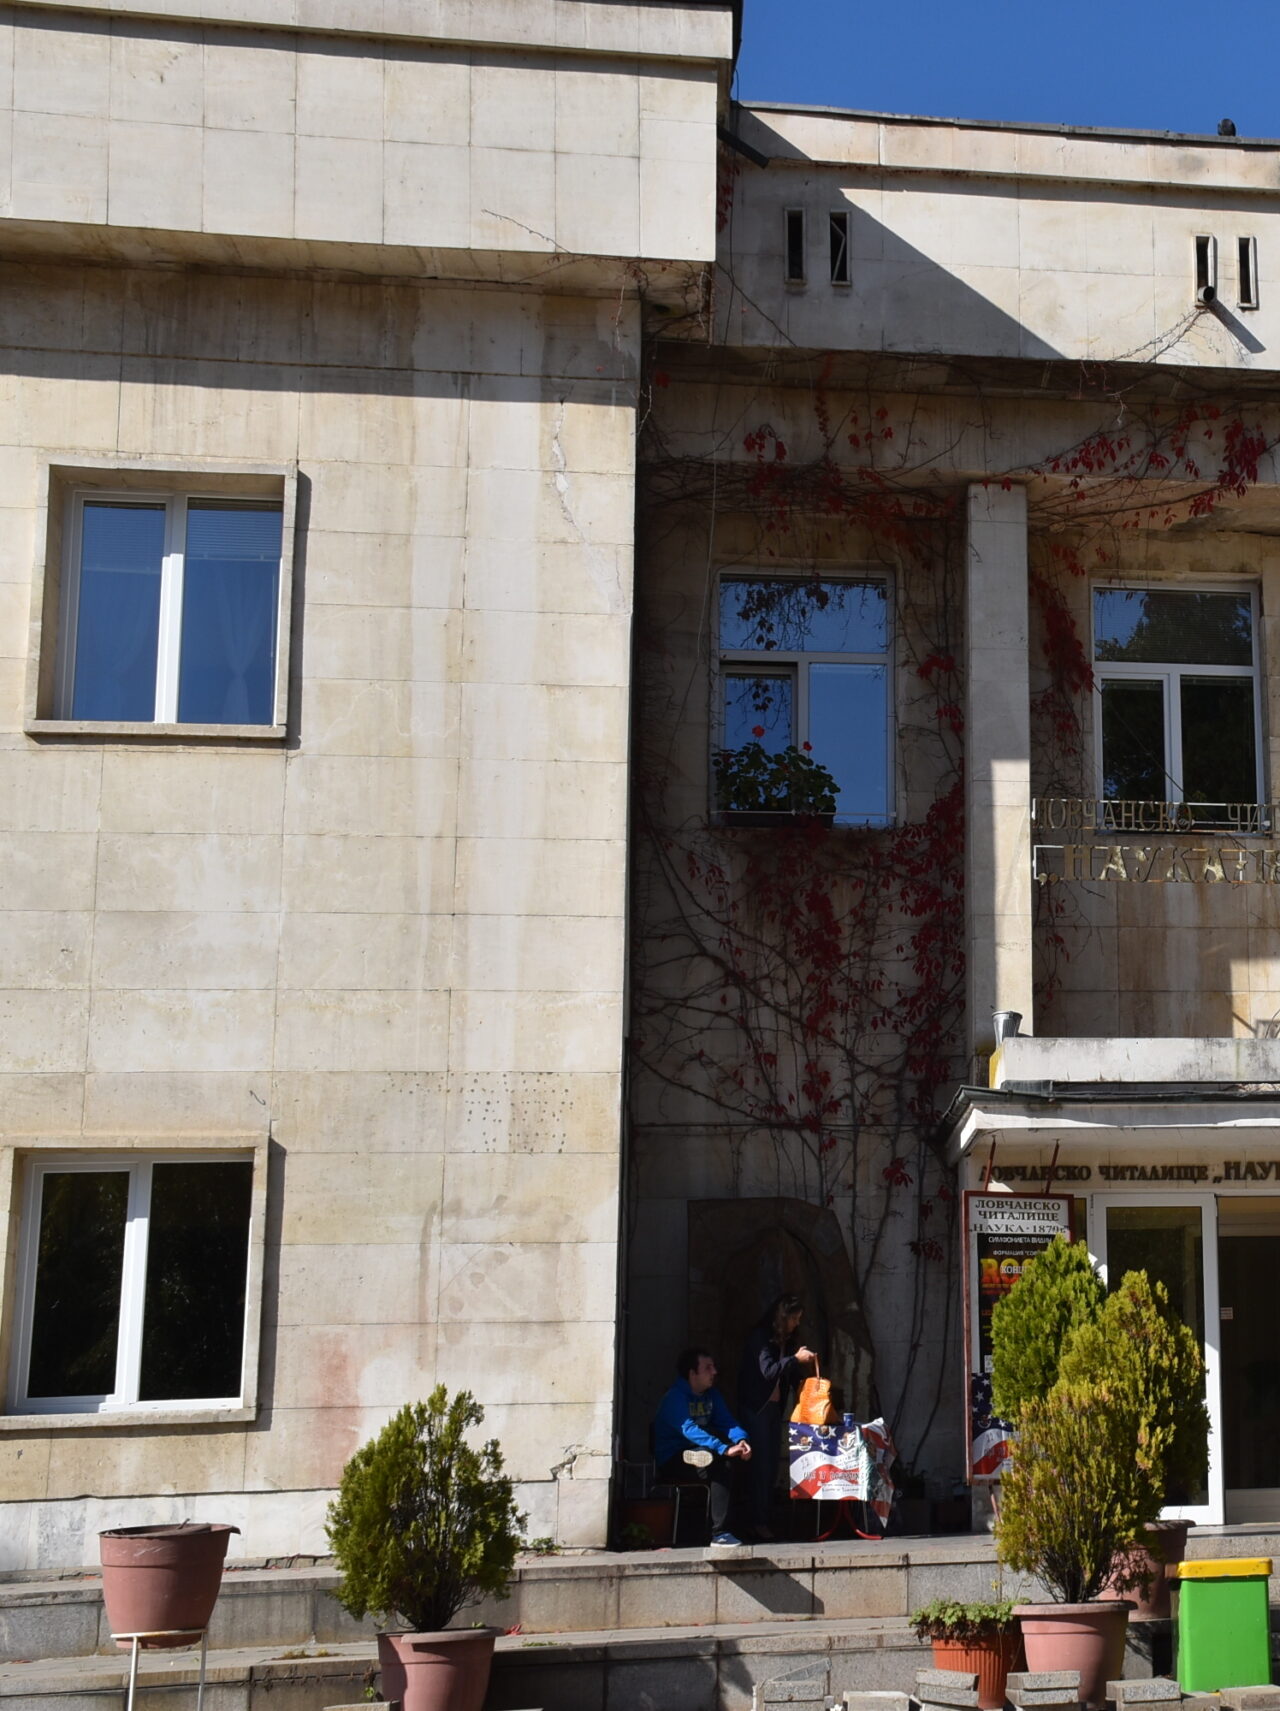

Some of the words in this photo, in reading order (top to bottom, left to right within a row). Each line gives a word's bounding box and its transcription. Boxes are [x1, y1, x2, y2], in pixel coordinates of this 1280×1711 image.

[1099, 1165, 1209, 1184] ЧИТАЛИЩЕ
[975, 1200, 1061, 1211] ЛОВЧАНСКО
[978, 1211, 1059, 1221] ЧИТАЛИЩЕ
